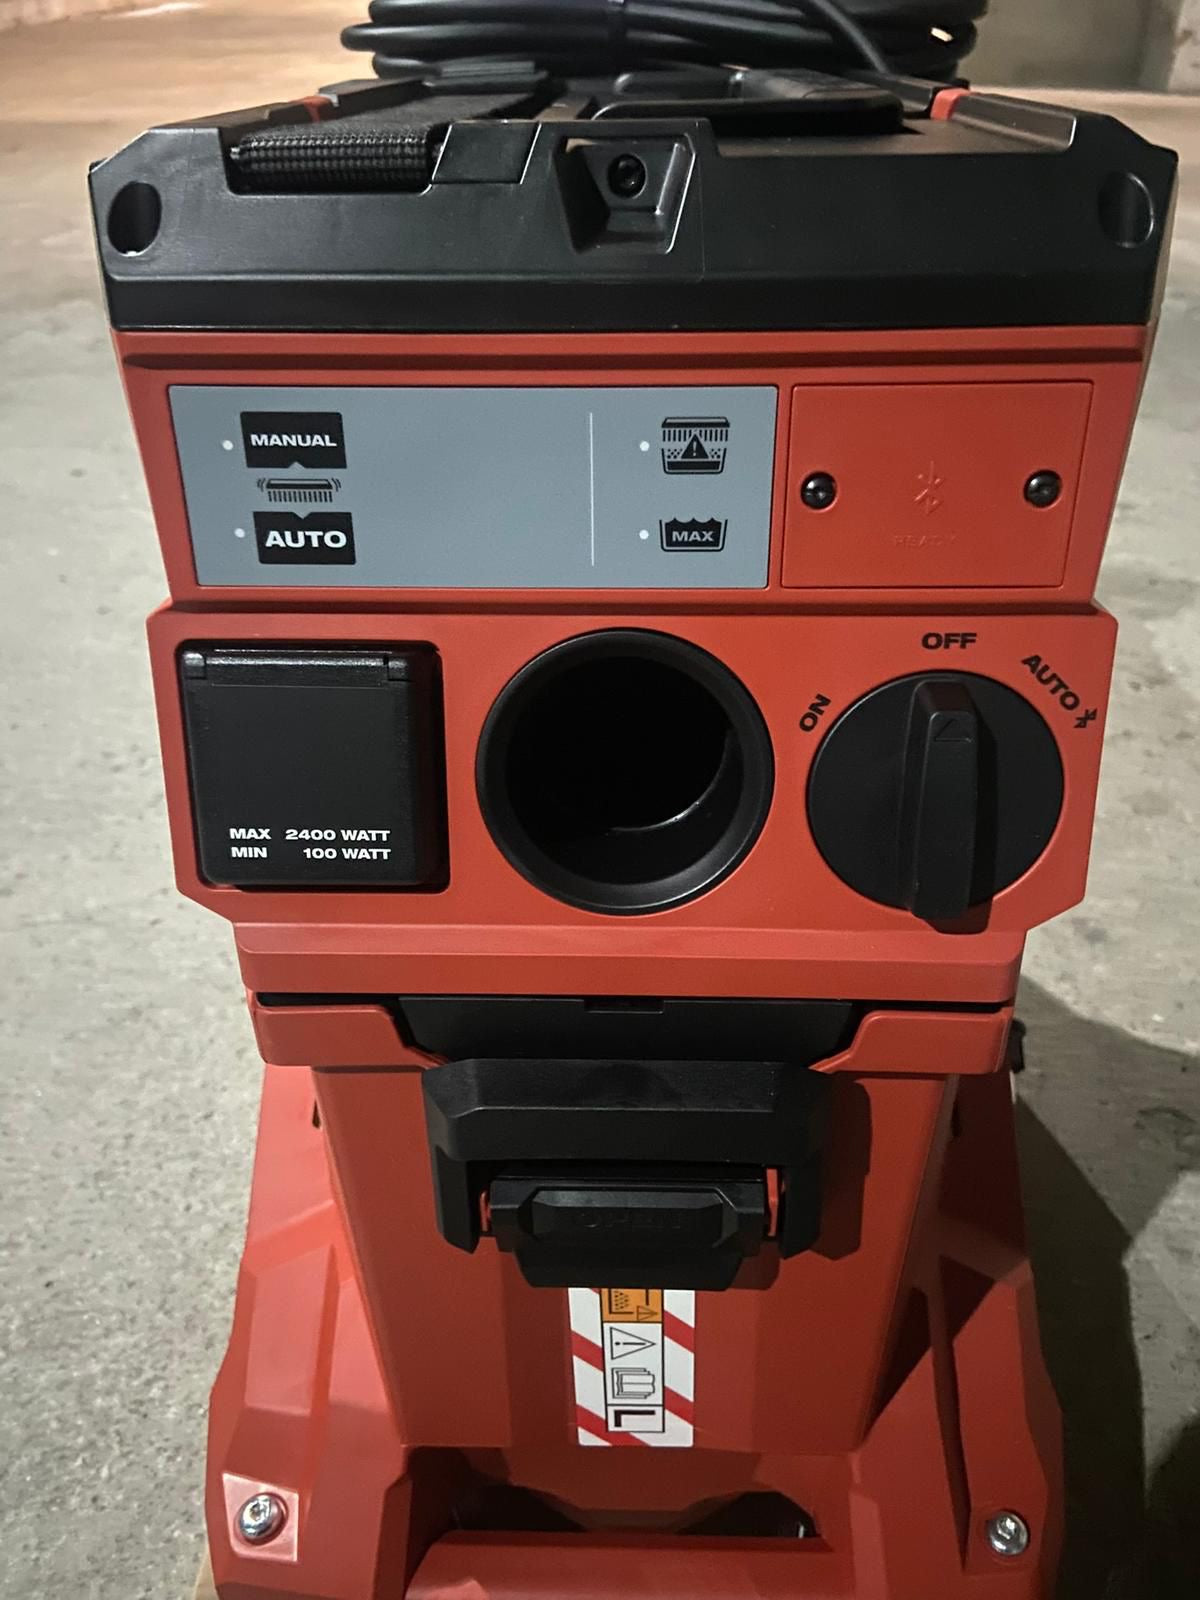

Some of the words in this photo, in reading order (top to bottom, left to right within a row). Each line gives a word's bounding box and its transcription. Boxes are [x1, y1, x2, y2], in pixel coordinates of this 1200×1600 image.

[250, 434, 337, 447] MANUAL
[265, 530, 347, 548] AUTO
[672, 530, 715, 542] MAX
[921, 632, 977, 650] OFF
[1021, 654, 1080, 711] AUTO
[799, 693, 832, 732] ON
[229, 828, 271, 840] MAX
[285, 829, 336, 841] 2400
[340, 830, 390, 841] WATT
[231, 847, 268, 859] MIN
[303, 848, 337, 860] 100
[341, 848, 391, 860] WATT
[614, 1409, 656, 1428] L
